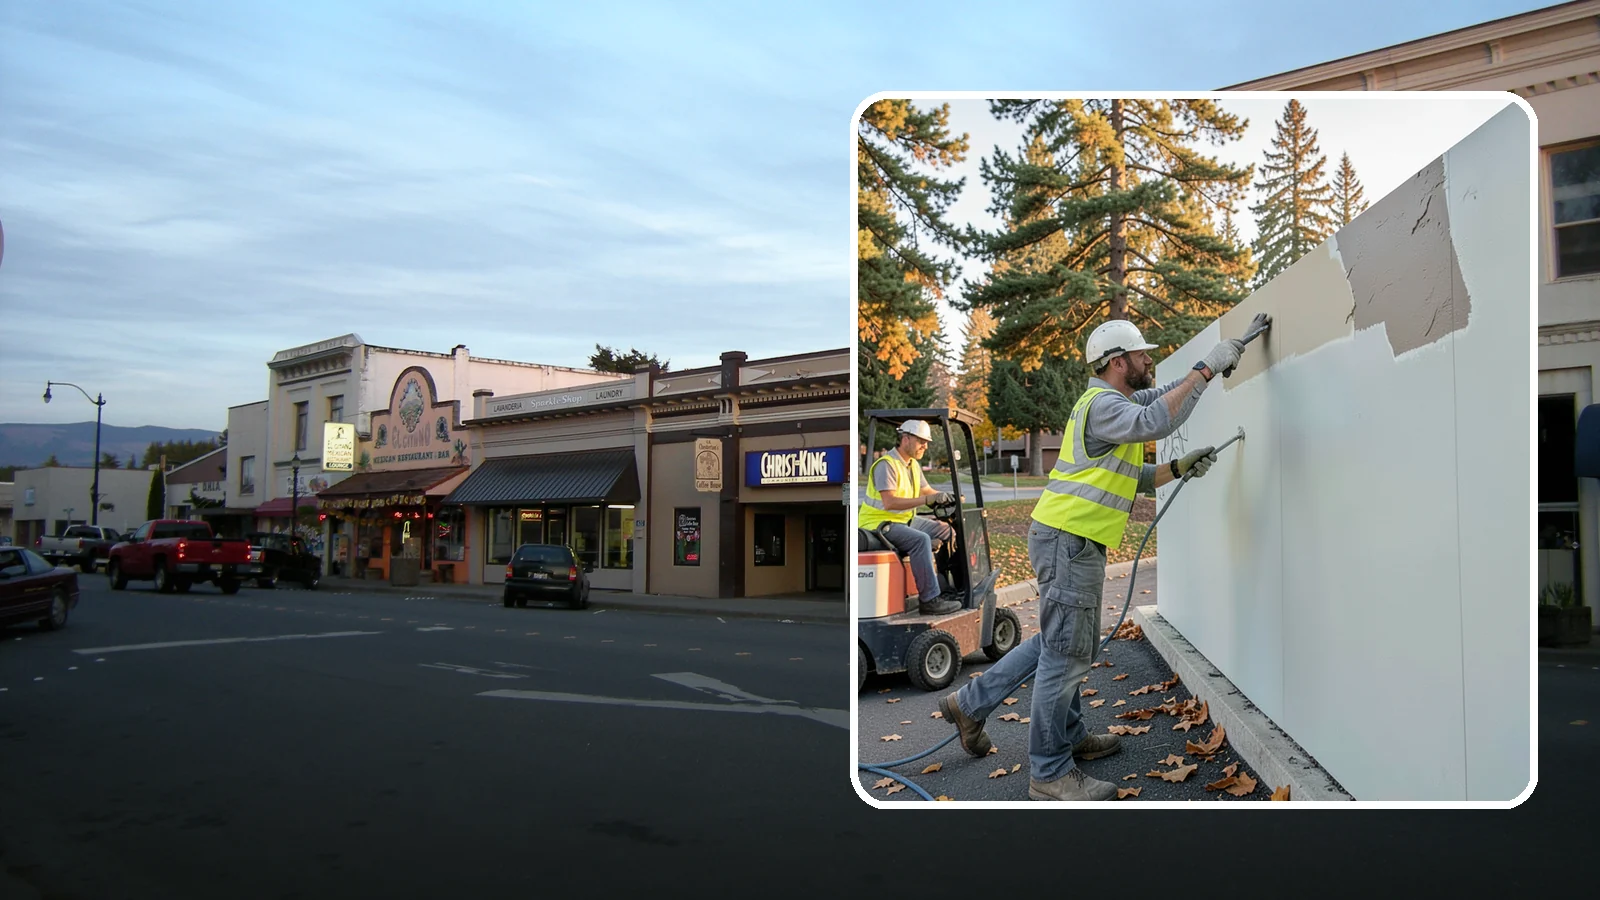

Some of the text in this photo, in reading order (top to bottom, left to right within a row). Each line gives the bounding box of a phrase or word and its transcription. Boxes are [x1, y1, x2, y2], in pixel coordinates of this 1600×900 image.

[595, 388, 624, 400] LAUNDRY
[493, 402, 522, 413] LAVANDERIA
[530, 394, 582, 409] Sparkle Shop
[373, 455, 396, 464] MEXICAN
[397, 451, 434, 462] RESTAURANT
[438, 450, 450, 459] BAR
[761, 450, 827, 478] CHRIST KING
